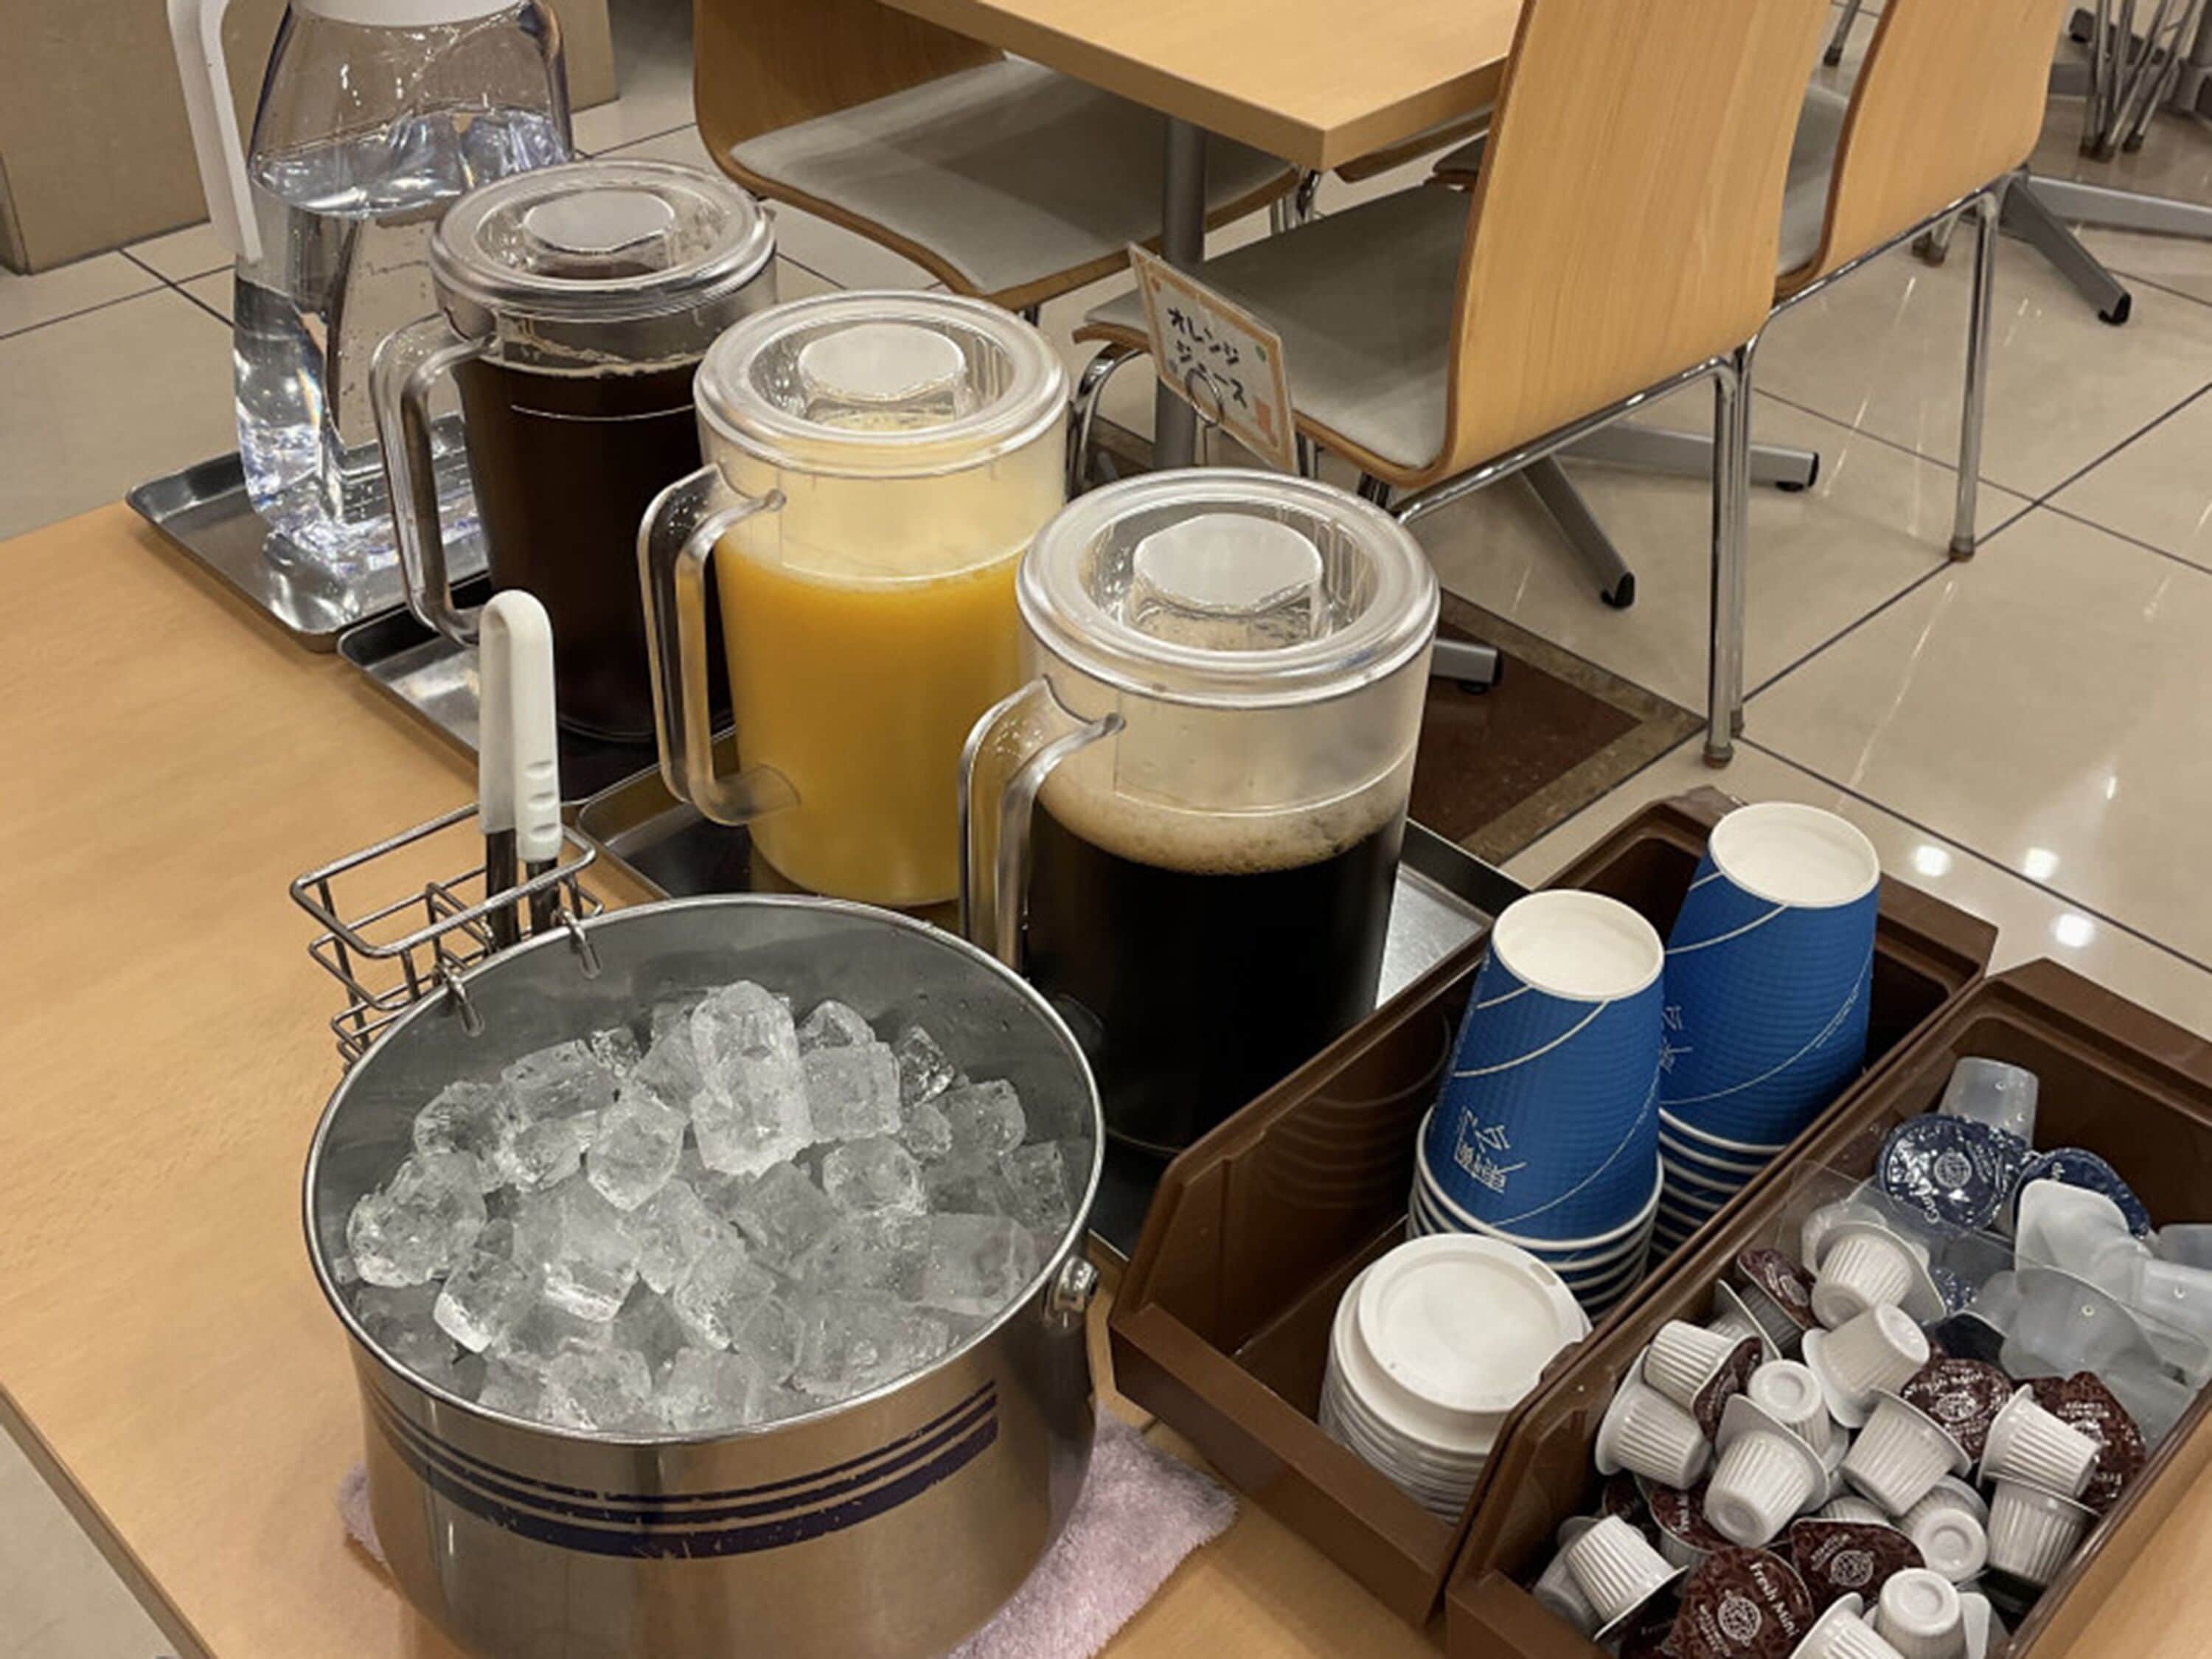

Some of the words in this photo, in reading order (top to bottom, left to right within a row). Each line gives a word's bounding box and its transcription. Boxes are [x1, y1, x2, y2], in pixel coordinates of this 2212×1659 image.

[1167, 307, 1240, 366] オレンジ
[1176, 339, 1248, 409] ジース
[1749, 1561, 1778, 1601] Fresh
